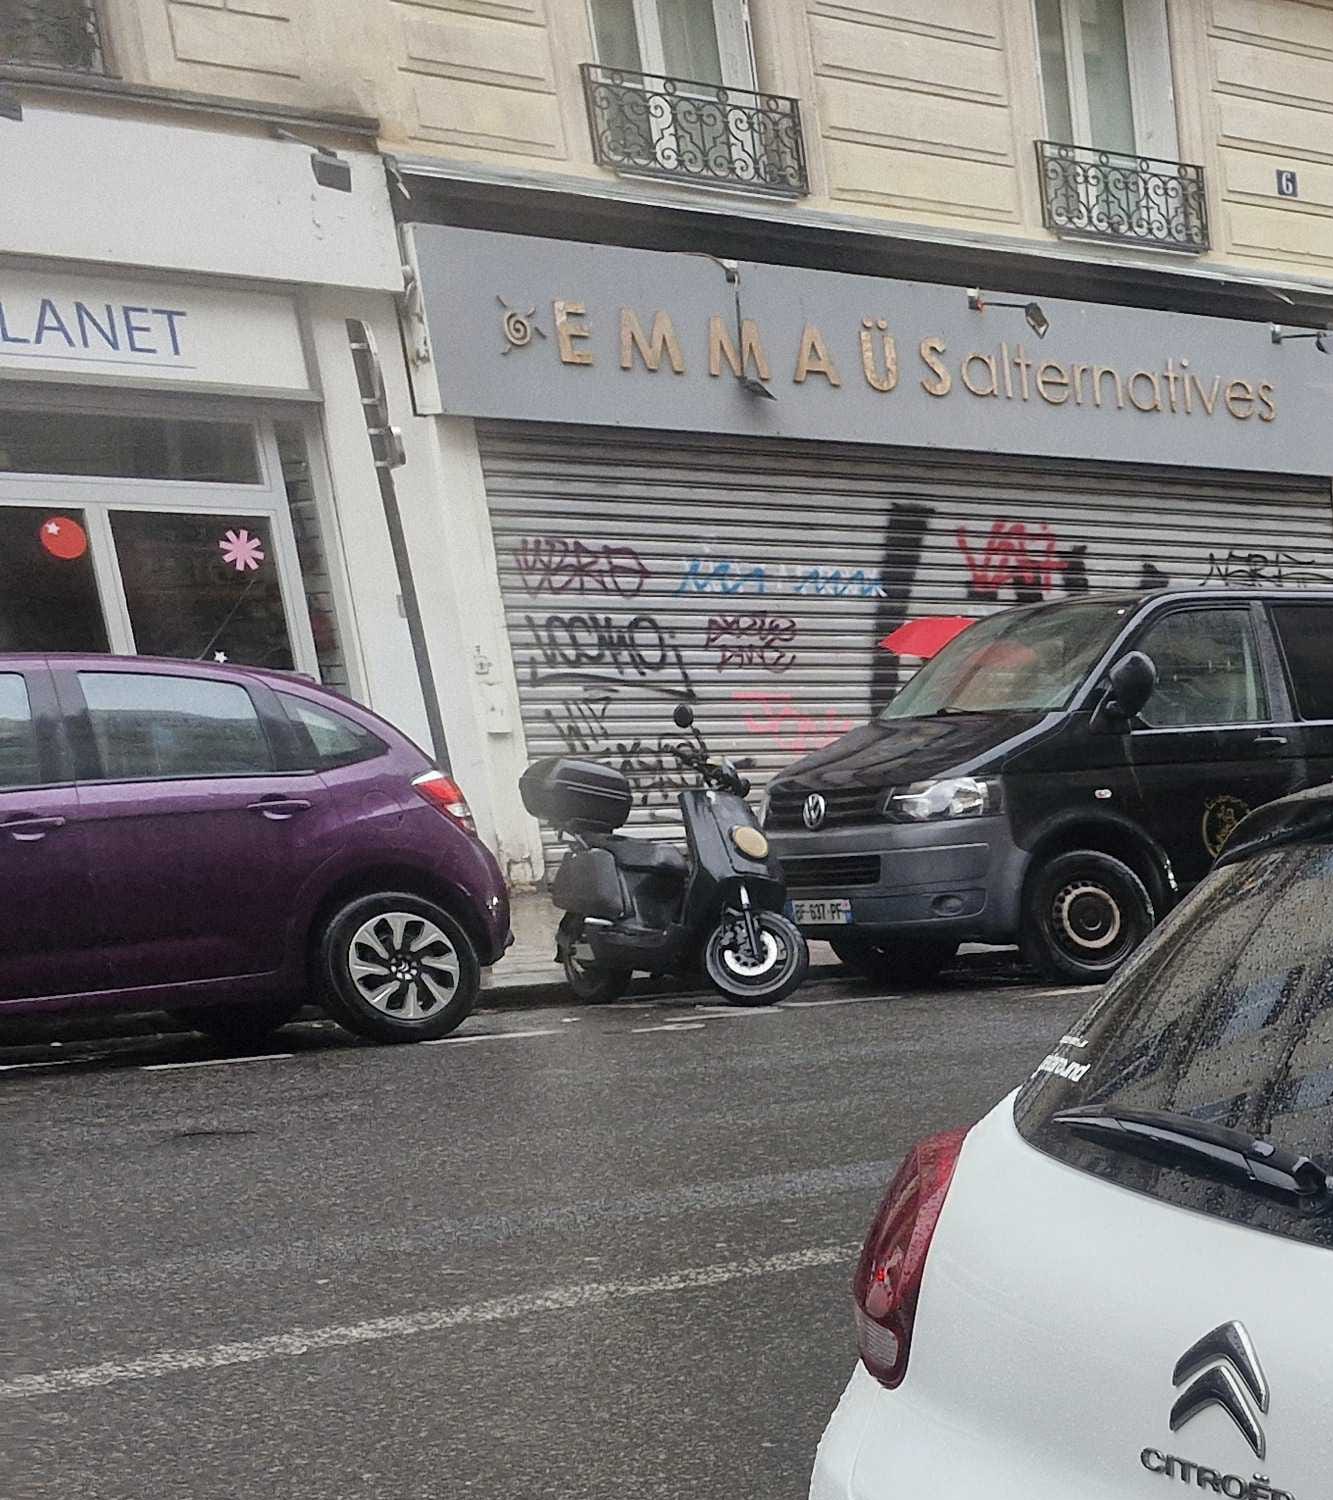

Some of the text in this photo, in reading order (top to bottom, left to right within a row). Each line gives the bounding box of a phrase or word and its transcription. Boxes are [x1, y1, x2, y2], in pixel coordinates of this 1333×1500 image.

[1282, 172, 1293, 195] 6
[552, 298, 1277, 422] EMMAÜS alternatives
